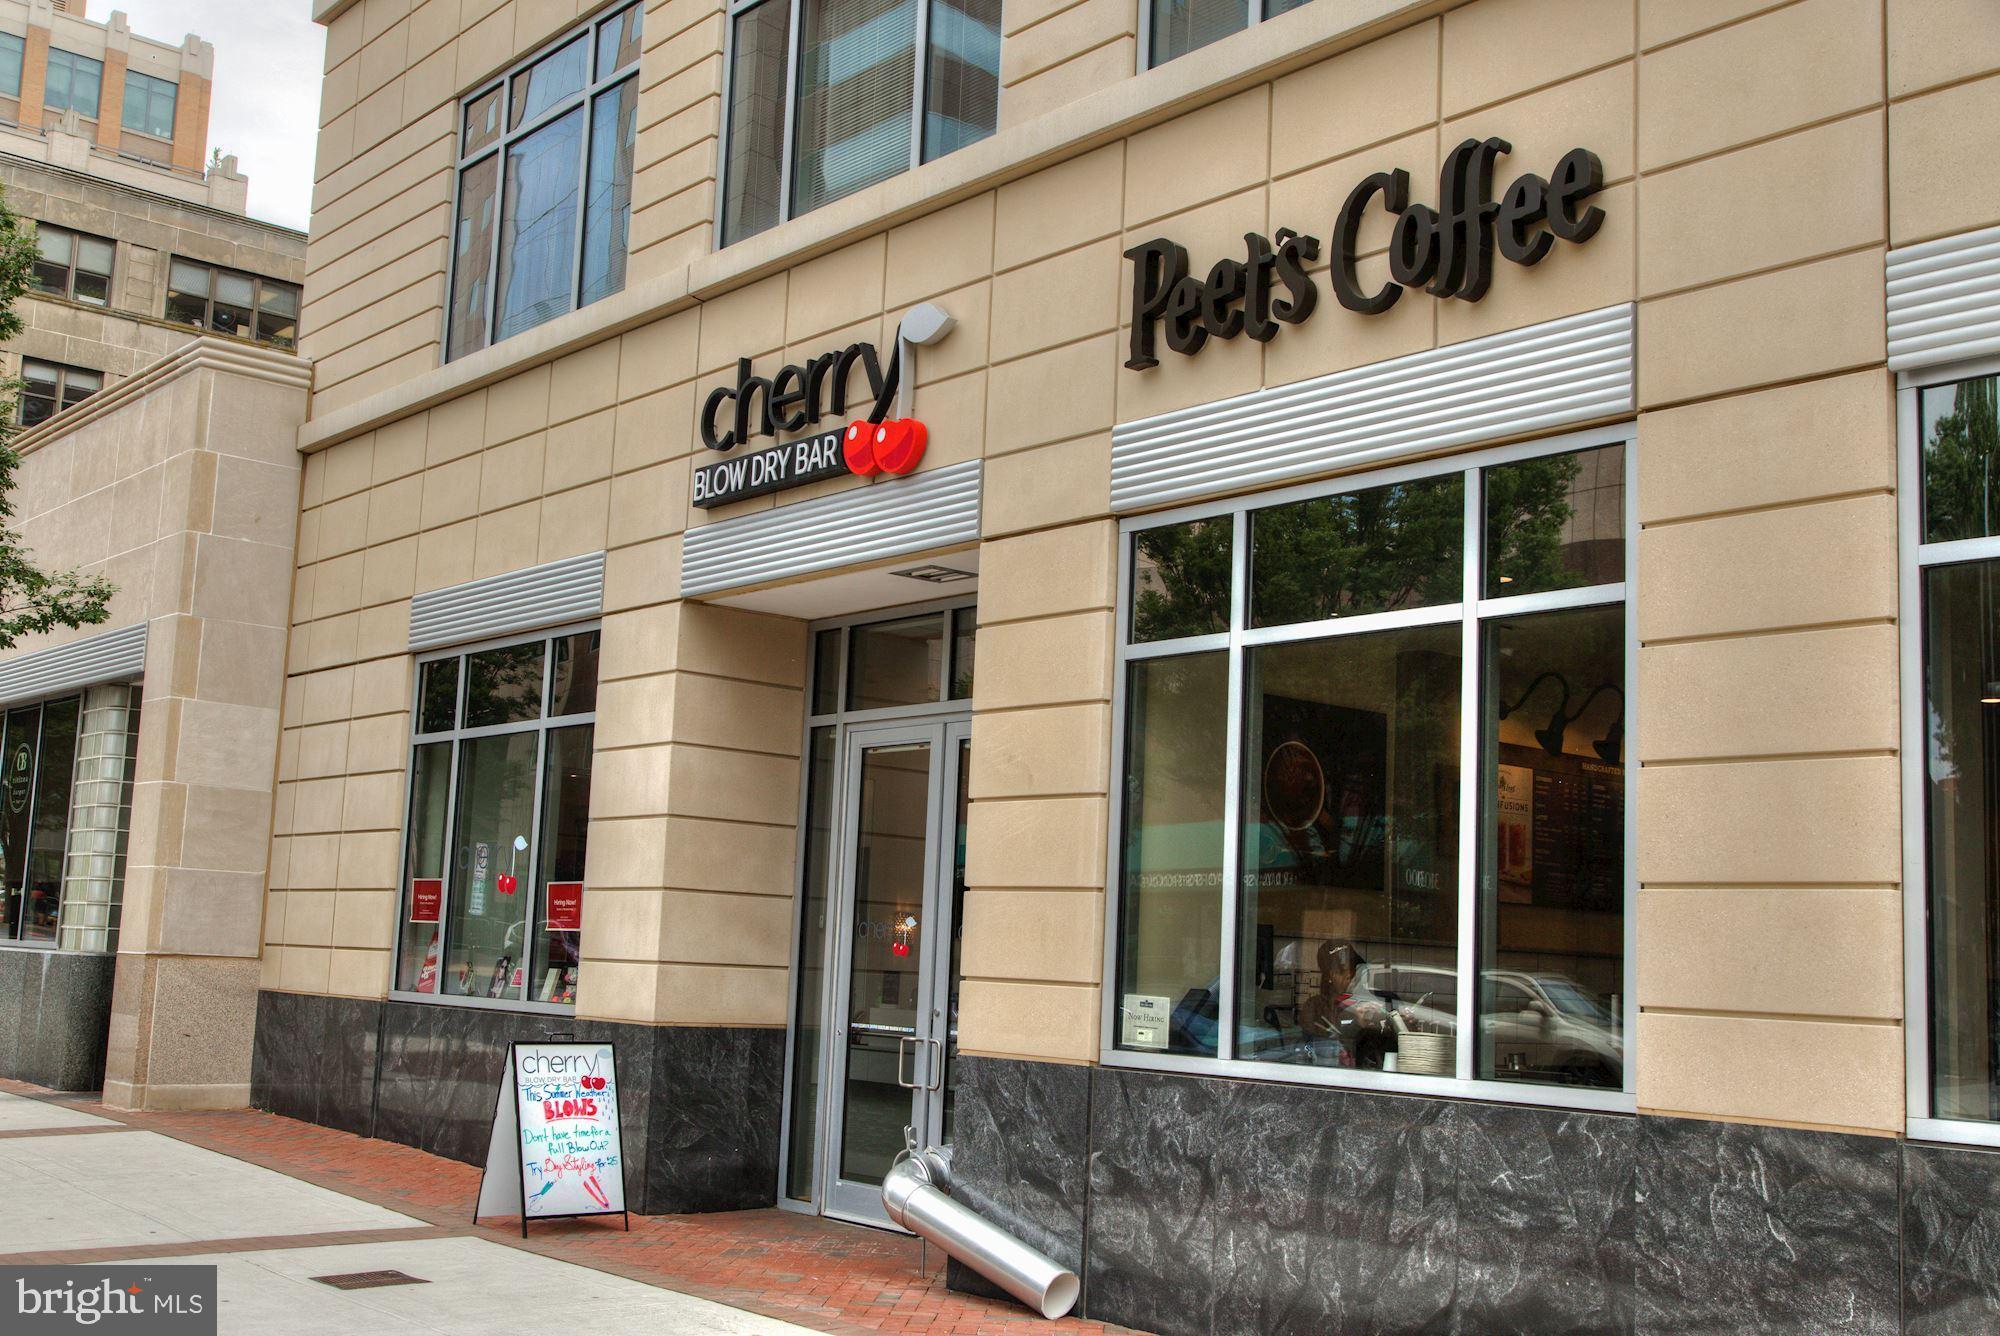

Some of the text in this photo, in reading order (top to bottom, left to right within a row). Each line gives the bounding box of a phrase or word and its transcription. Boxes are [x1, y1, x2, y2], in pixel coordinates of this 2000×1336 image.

[1123, 137, 1606, 371] Peet's Coffee
[701, 321, 901, 451] cherry
[693, 434, 838, 502] BLOW DRY BAR
[522, 1049, 599, 1077] cherry
[563, 1075, 577, 1083] BAR
[523, 1087, 543, 1102] This
[543, 1098, 598, 1121] BLOWS
[551, 1125, 571, 1141] have
[547, 1141, 564, 1155] full
[526, 1161, 543, 1180] Try
